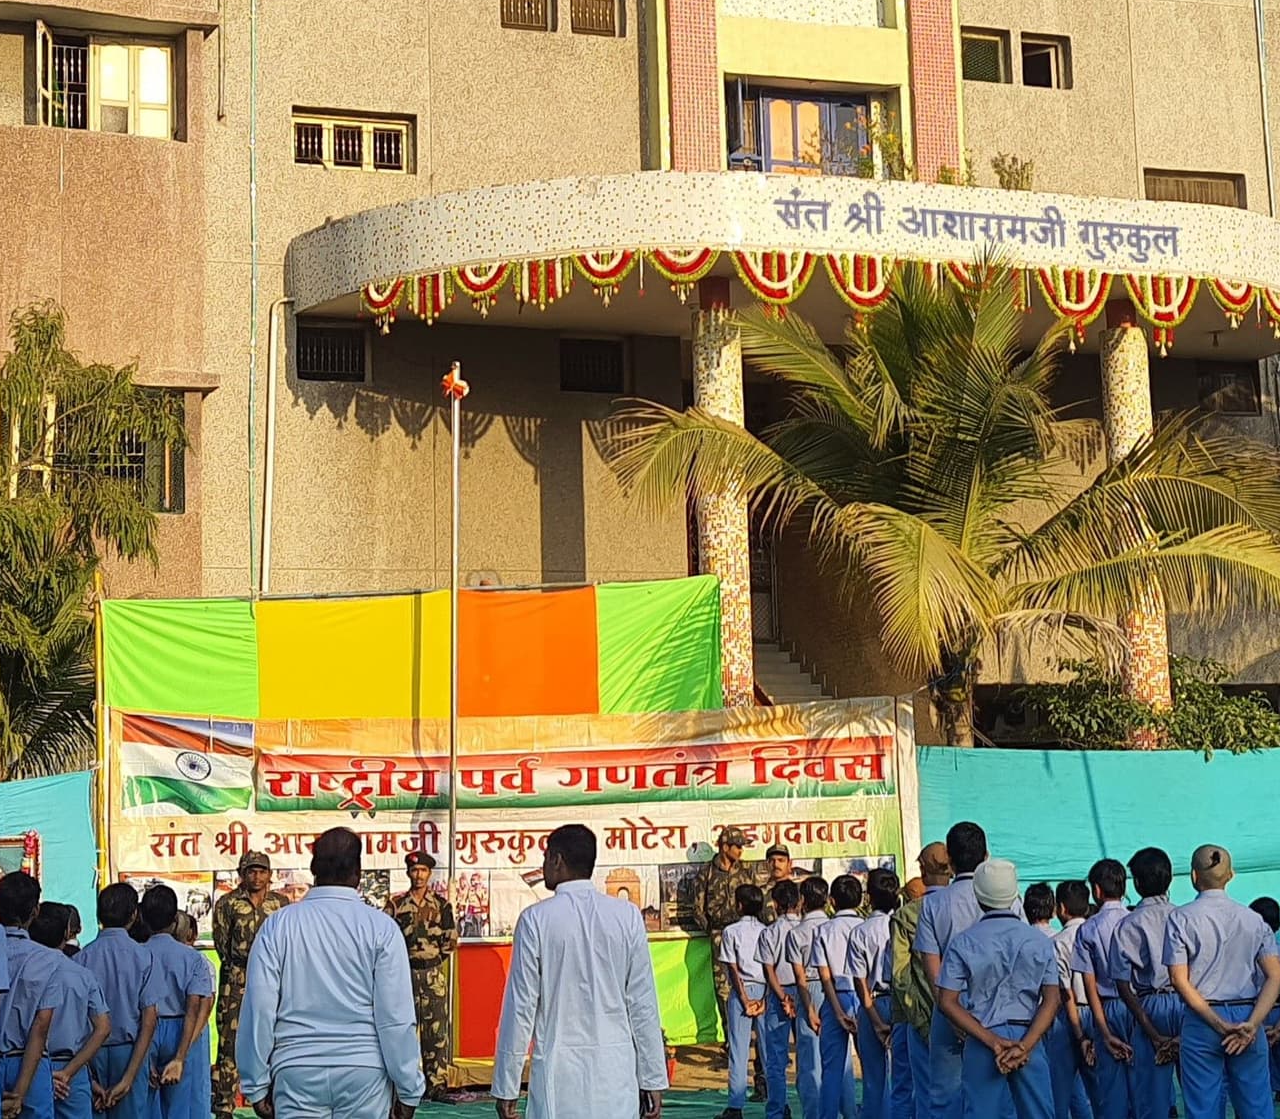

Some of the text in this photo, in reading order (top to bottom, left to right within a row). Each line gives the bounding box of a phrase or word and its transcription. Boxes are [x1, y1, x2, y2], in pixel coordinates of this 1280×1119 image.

[773, 187, 1180, 263] संत श्री आशारामजी गुरुकुल
[264, 745, 887, 810] राष्ट्रीय पर्व गणतंत्र दिवस
[149, 821, 202, 858] संत
[214, 820, 252, 855] श्री
